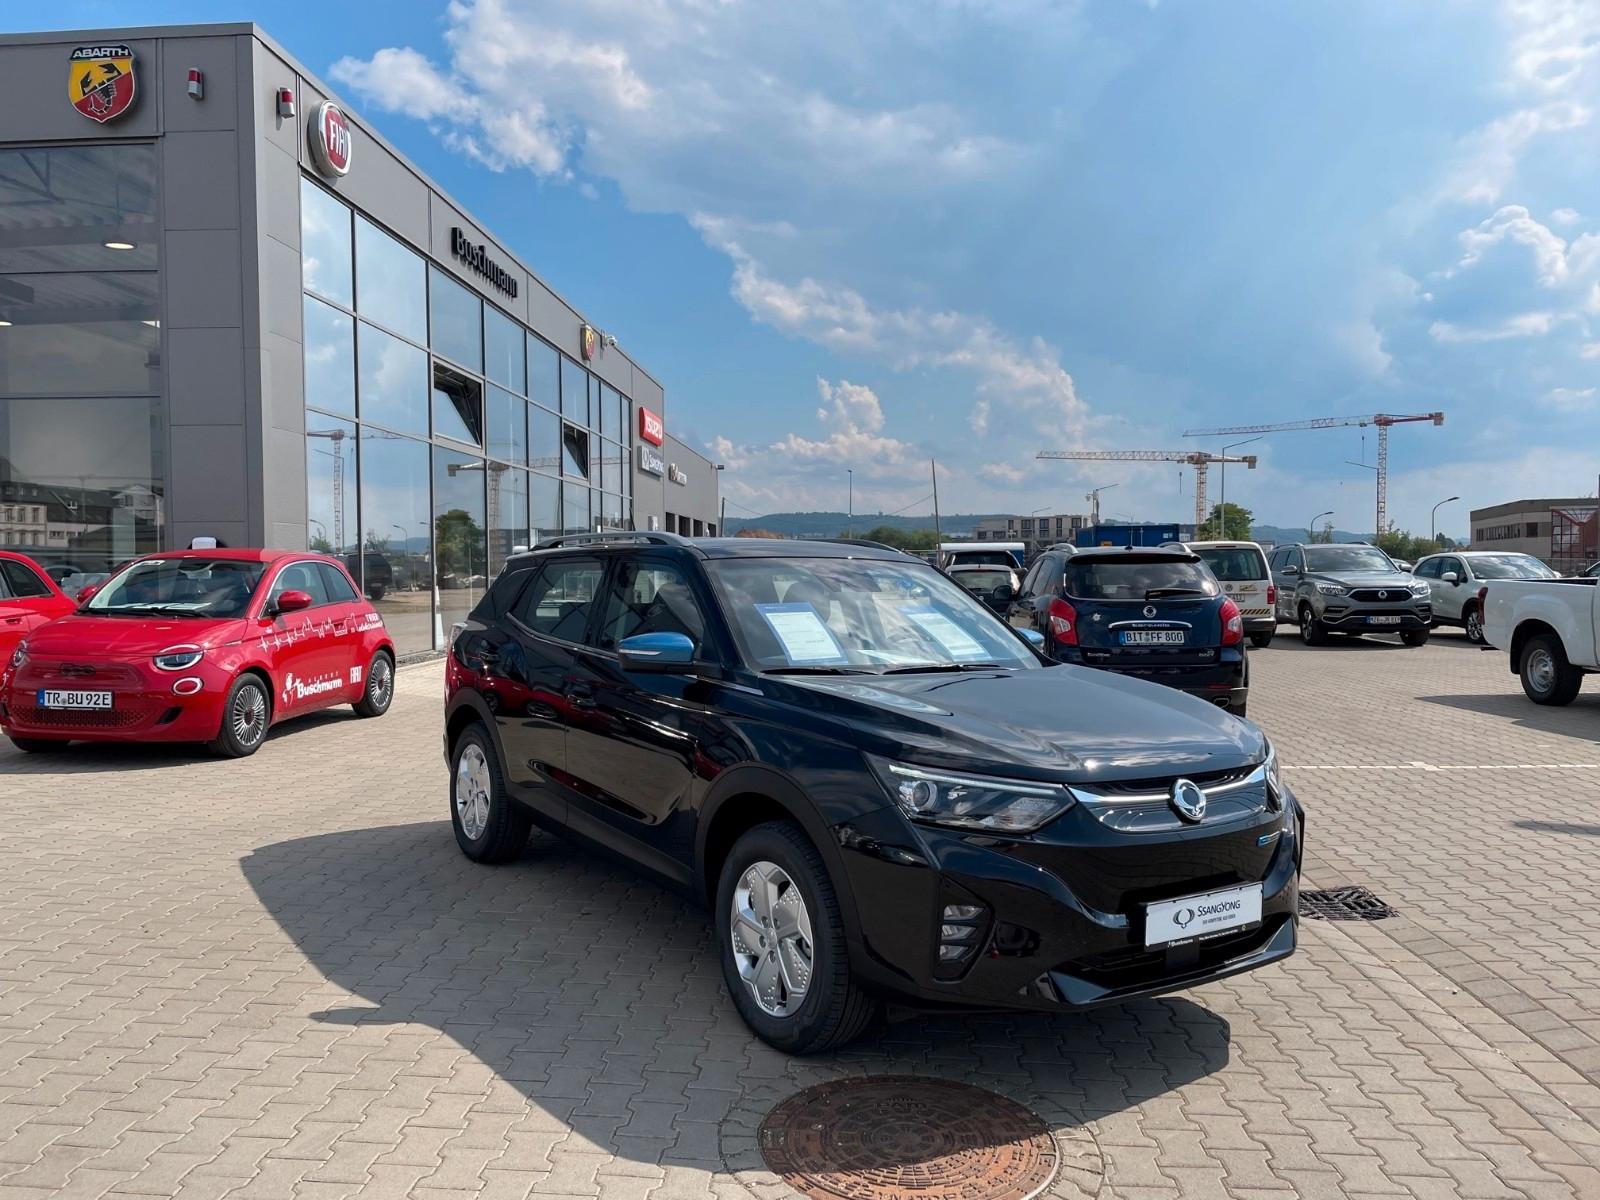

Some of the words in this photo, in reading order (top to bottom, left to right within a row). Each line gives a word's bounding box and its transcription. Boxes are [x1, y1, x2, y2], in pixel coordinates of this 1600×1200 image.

[72, 47, 129, 58] ABARTH
[329, 119, 351, 161] FIAT
[452, 227, 517, 298] Buschmann
[1126, 632, 1143, 642] BIT
[1151, 632, 1163, 642] FF
[1165, 632, 1182, 642] 800
[350, 665, 363, 684] FIAT
[296, 678, 343, 699] Buschmann
[46, 692, 60, 705] TR
[67, 693, 83, 705] BU
